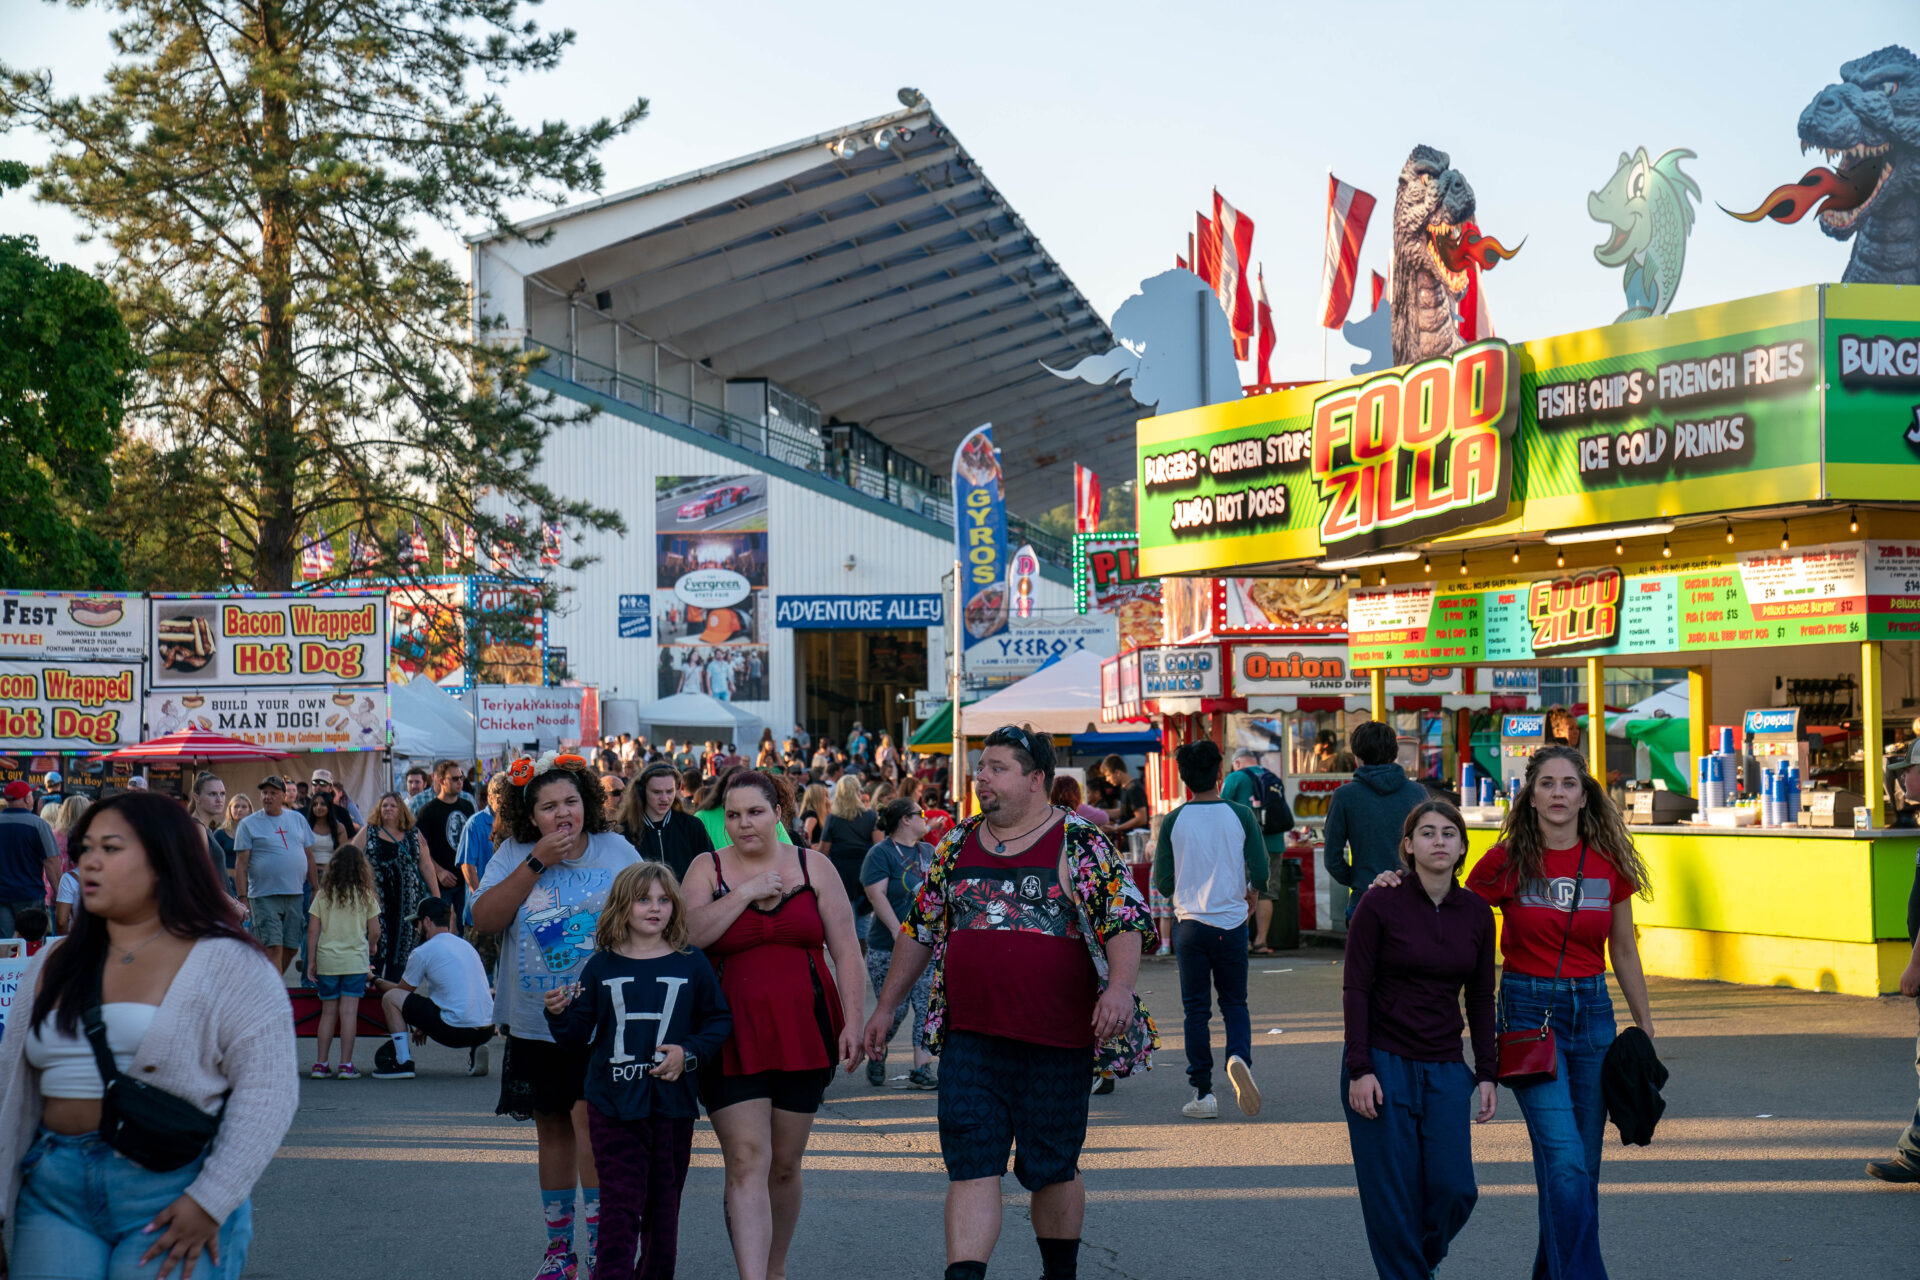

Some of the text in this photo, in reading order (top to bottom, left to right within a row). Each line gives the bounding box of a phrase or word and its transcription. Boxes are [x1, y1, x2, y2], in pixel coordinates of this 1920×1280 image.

[1842, 338, 1920, 376] BURG
[1537, 343, 1805, 420] FISH & CHIPS FRENCH FRIES
[1312, 341, 1507, 478] FOOD
[1579, 417, 1745, 472] ICE COLD DRINKS
[1144, 429, 1312, 486] BURGERS CHICKEN STRIPS
[1321, 430, 1499, 542] ZILLA
[1171, 485, 1286, 529] JUMBO HOT DOGS
[966, 488, 996, 585] GYROS
[1091, 547, 1139, 586] PI
[683, 578, 742, 592] Evergreen
[1529, 567, 1621, 619] FOOD
[1726, 588, 1737, 600] $14
[1823, 583, 1836, 595] $14
[777, 597, 942, 622] ADVENTURE ALLEY
[1811, 600, 1837, 616] Burger
[1841, 600, 1853, 613] $12
[1890, 597, 1920, 609] Deluxe
[224, 605, 284, 636] Bacon
[291, 605, 375, 641] Wrapped
[1726, 608, 1739, 621] $15
[1532, 605, 1616, 649] ZILLA
[1777, 626, 1786, 639] $7
[1849, 621, 1860, 634] $6
[0, 632, 43, 646] TYLE!
[997, 635, 1086, 656] YEERO'S
[236, 643, 362, 678] Hot Dog
[1165, 652, 1212, 672] COLD
[1244, 652, 1345, 681] Onion
[44, 669, 131, 706] Wrapped
[1310, 681, 1371, 690] HAND DIPP
[211, 699, 327, 711] BUILD YOUR OWN
[481, 698, 534, 714] Teriyaki
[533, 699, 580, 711] Yakisoba
[54, 708, 117, 744] Dog
[218, 711, 320, 730] MAN DOG!
[479, 717, 535, 731] Chicken
[536, 715, 576, 726] Noodle
[1517, 720, 1540, 734] pepsi
[1763, 713, 1791, 729] pepsi
[67, 776, 83, 785] Fat
[84, 776, 103, 788] Boy
[519, 974, 575, 990] STIT
[601, 976, 689, 1064] H
[612, 1062, 656, 1083] POT
